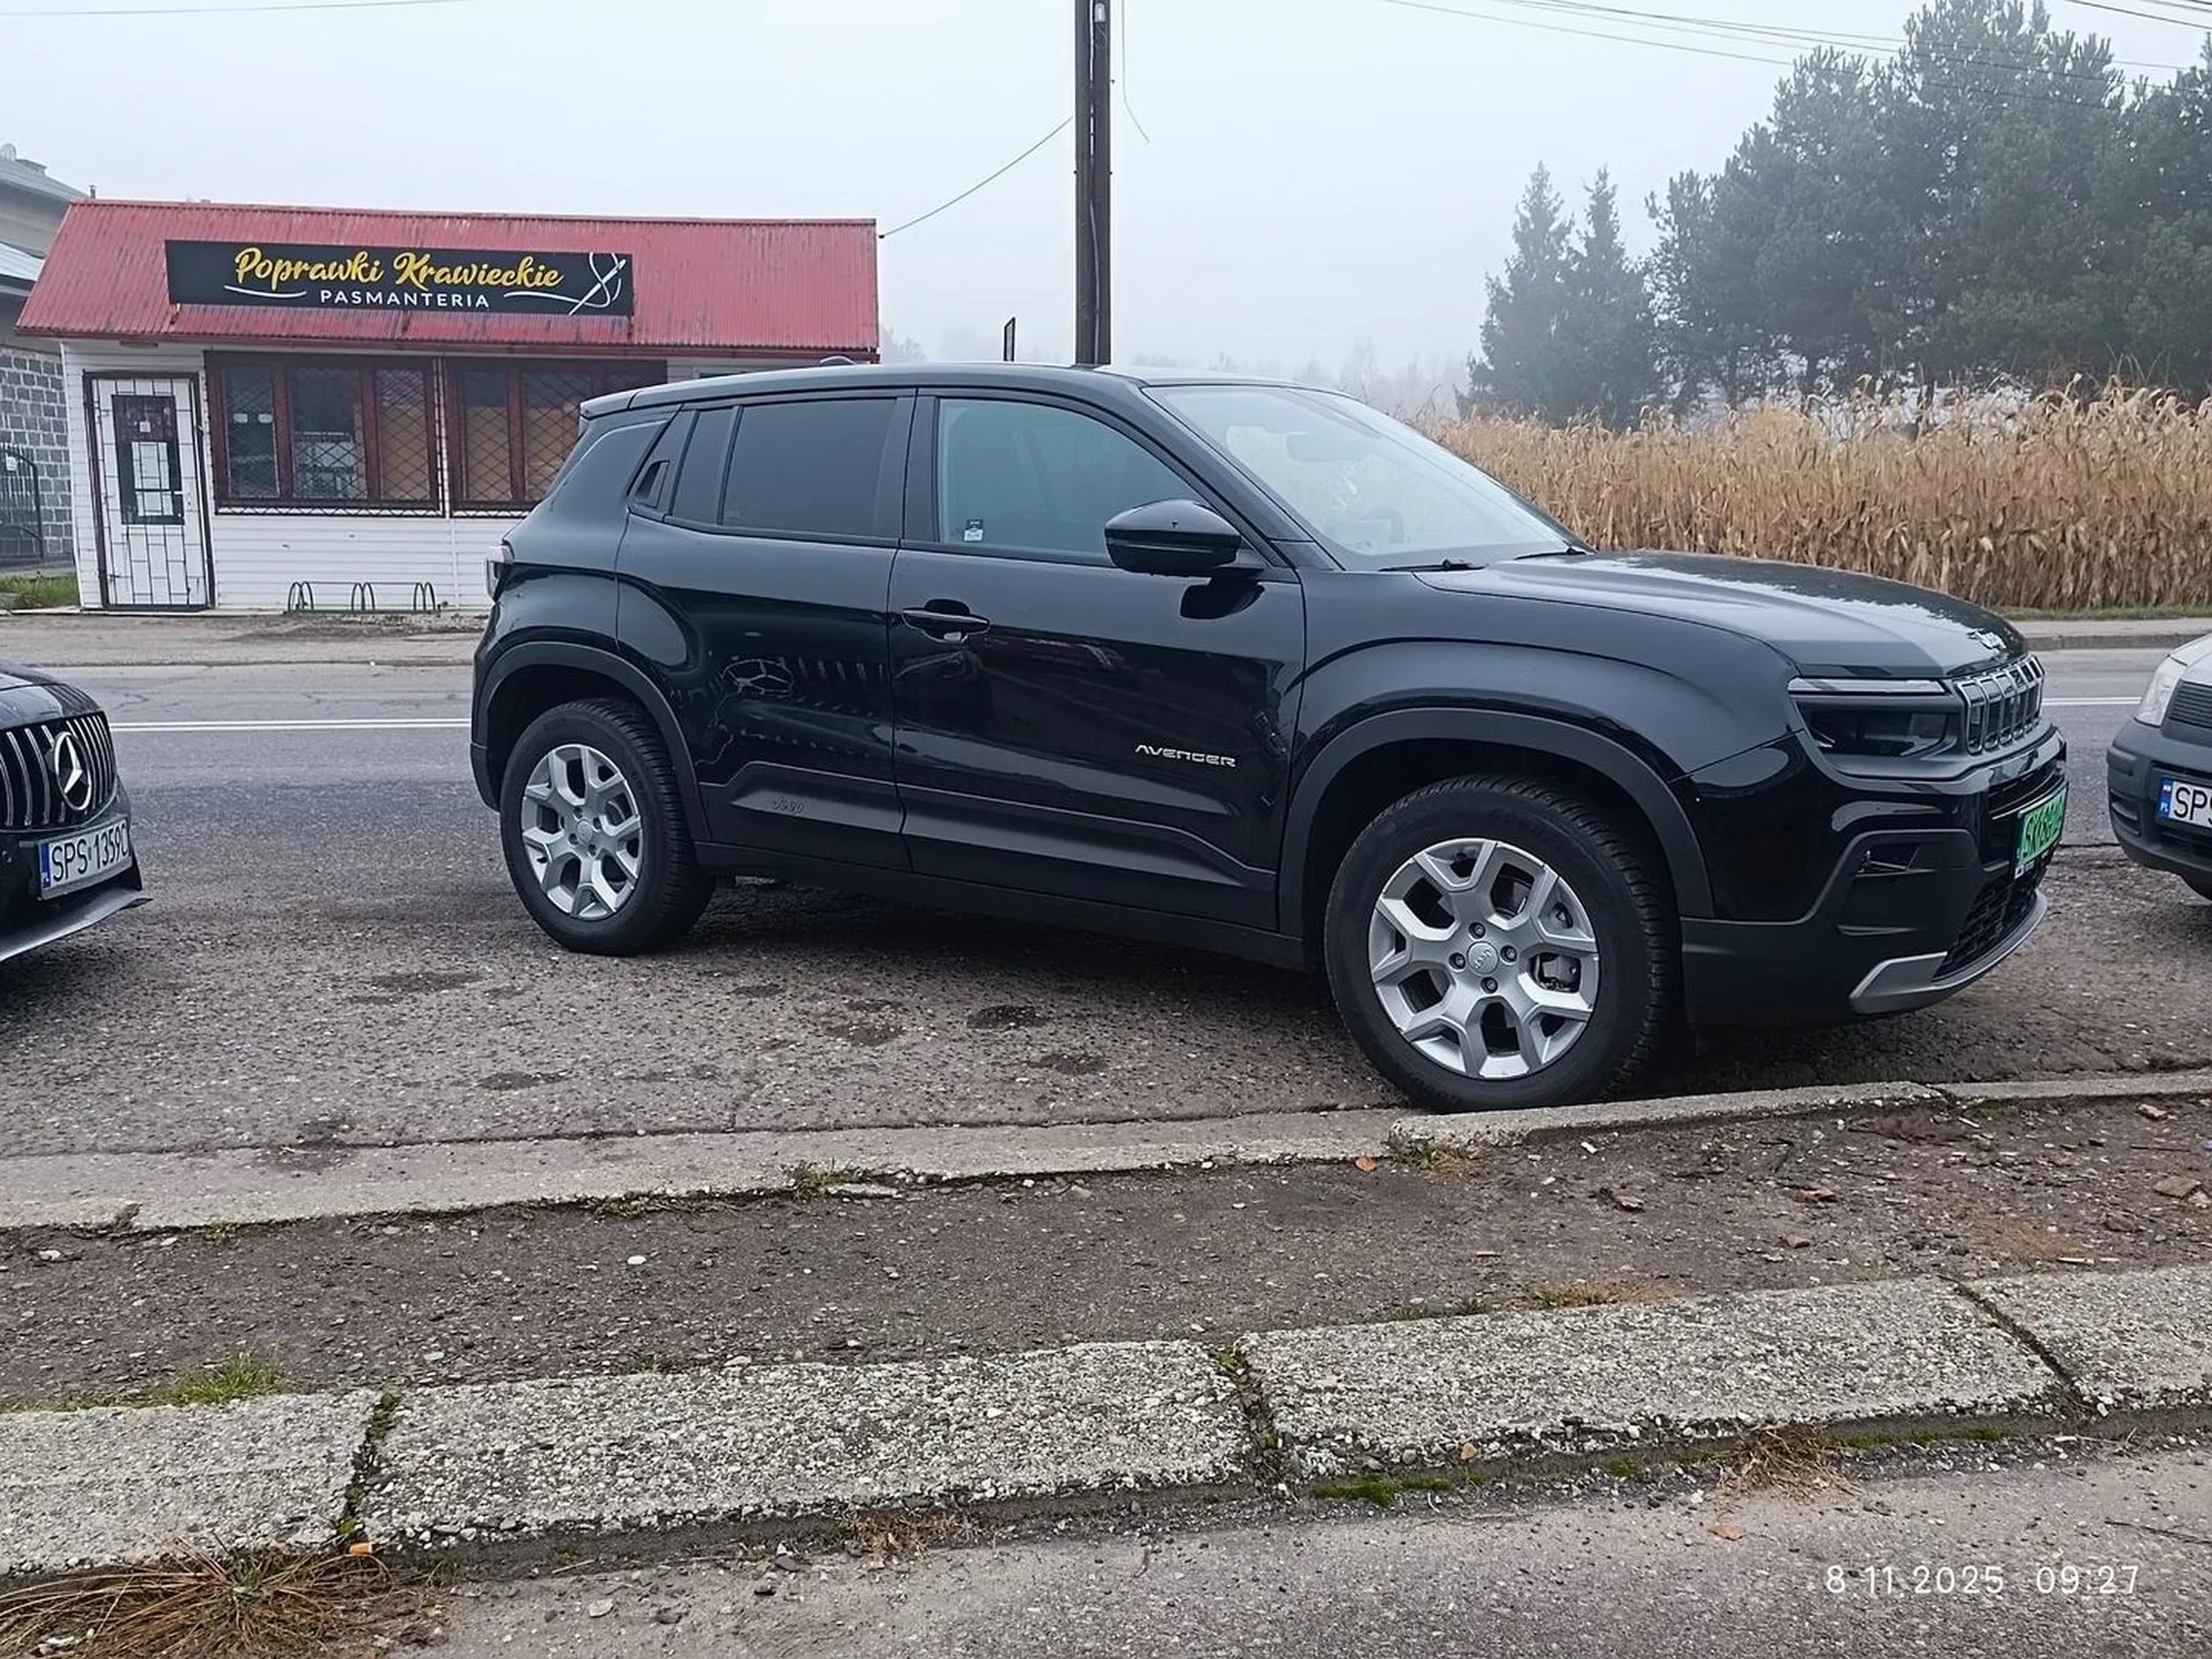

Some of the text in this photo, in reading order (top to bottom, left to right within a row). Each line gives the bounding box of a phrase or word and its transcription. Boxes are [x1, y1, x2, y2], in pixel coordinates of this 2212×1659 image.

[234, 247, 565, 291] Poprawki Krawieckie
[319, 290, 489, 308] PASMANTERIA
[1135, 744, 1236, 767] AVENGER
[2173, 786, 2212, 825] SP
